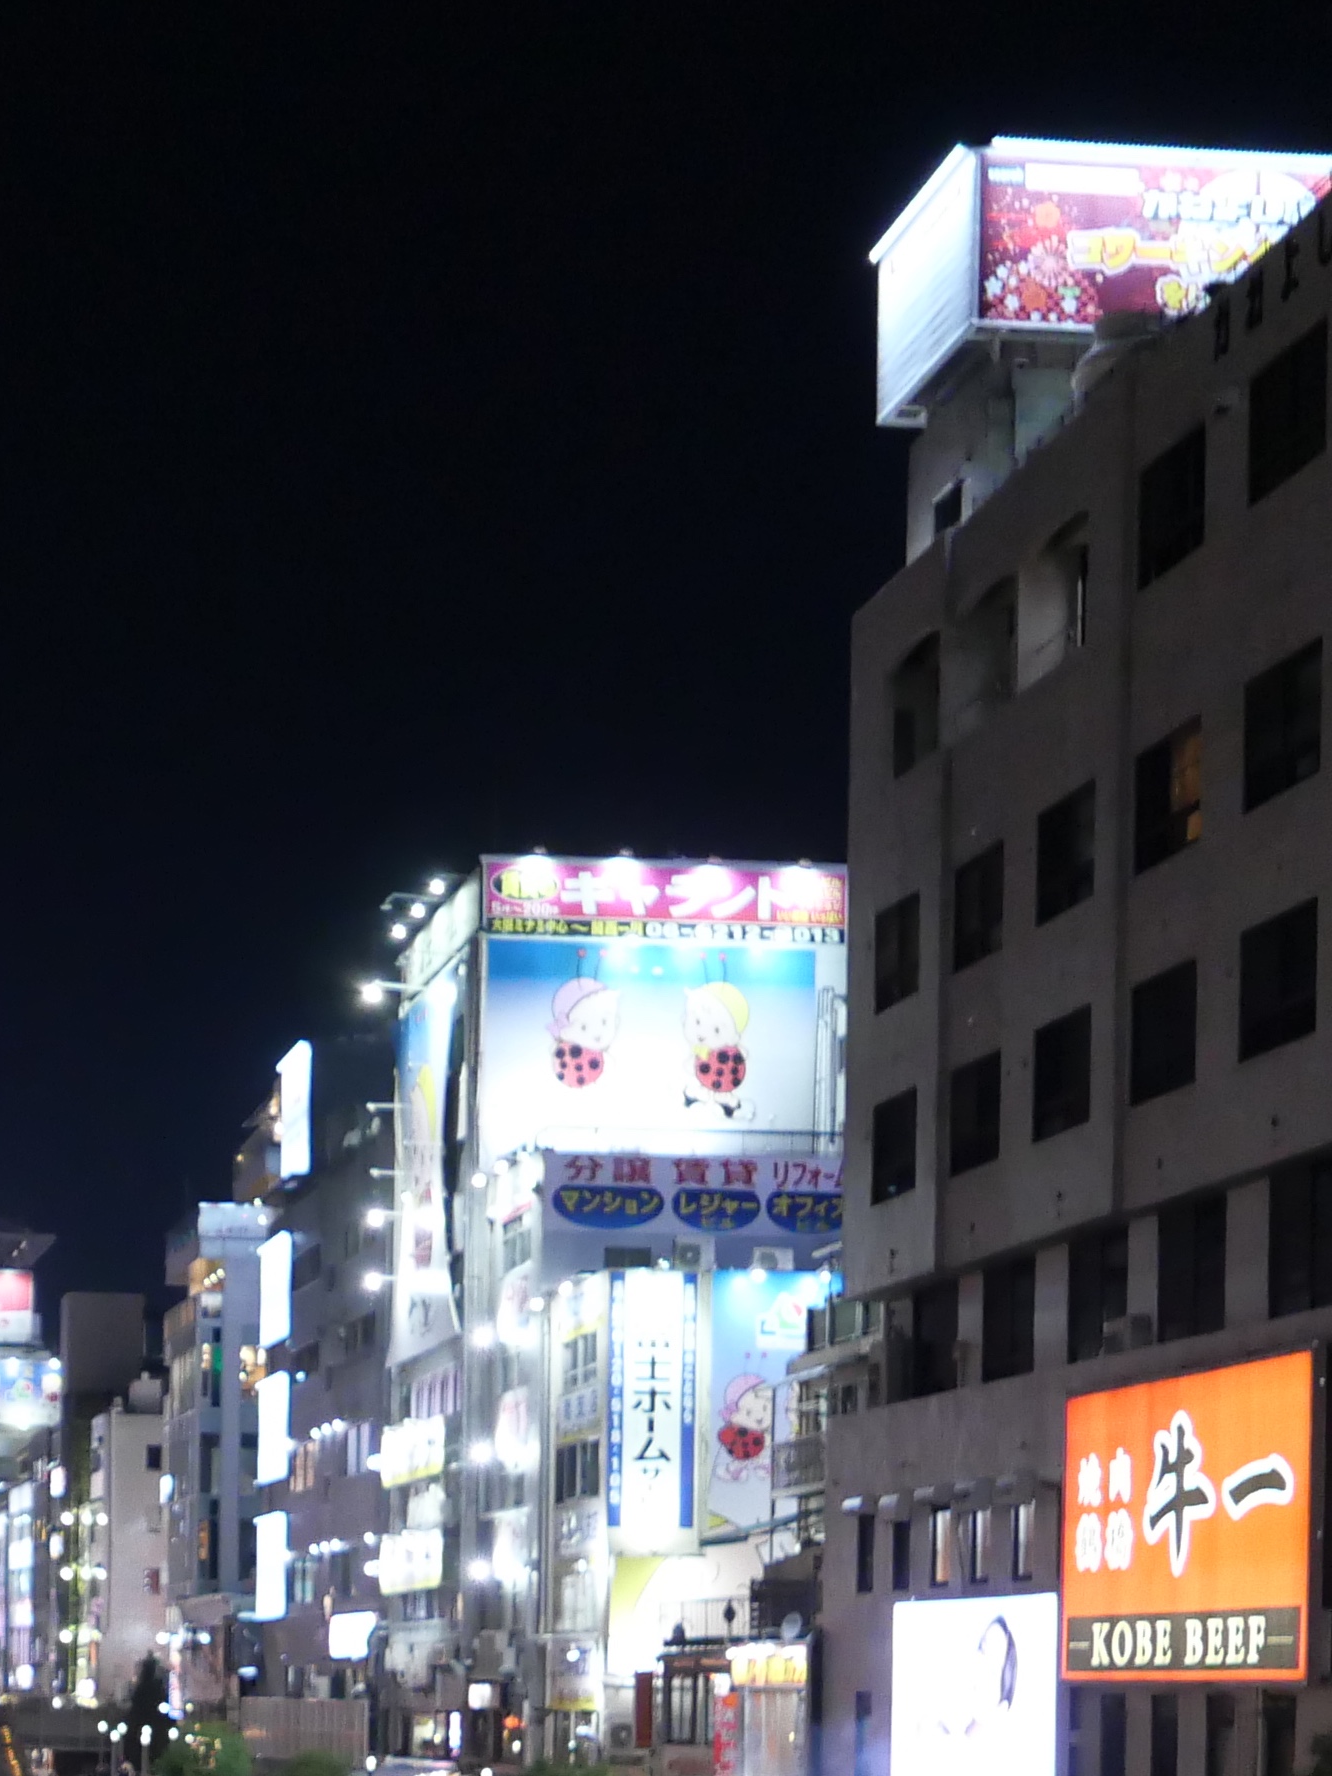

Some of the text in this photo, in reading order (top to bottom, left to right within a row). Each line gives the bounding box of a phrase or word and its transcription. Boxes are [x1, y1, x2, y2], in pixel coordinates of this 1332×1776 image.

[559, 1189, 662, 1216] マンション
[678, 1191, 760, 1217] レジャー
[1145, 1411, 1292, 1575] 牛一
[1089, 1614, 1267, 1667] KOBE BEEF
